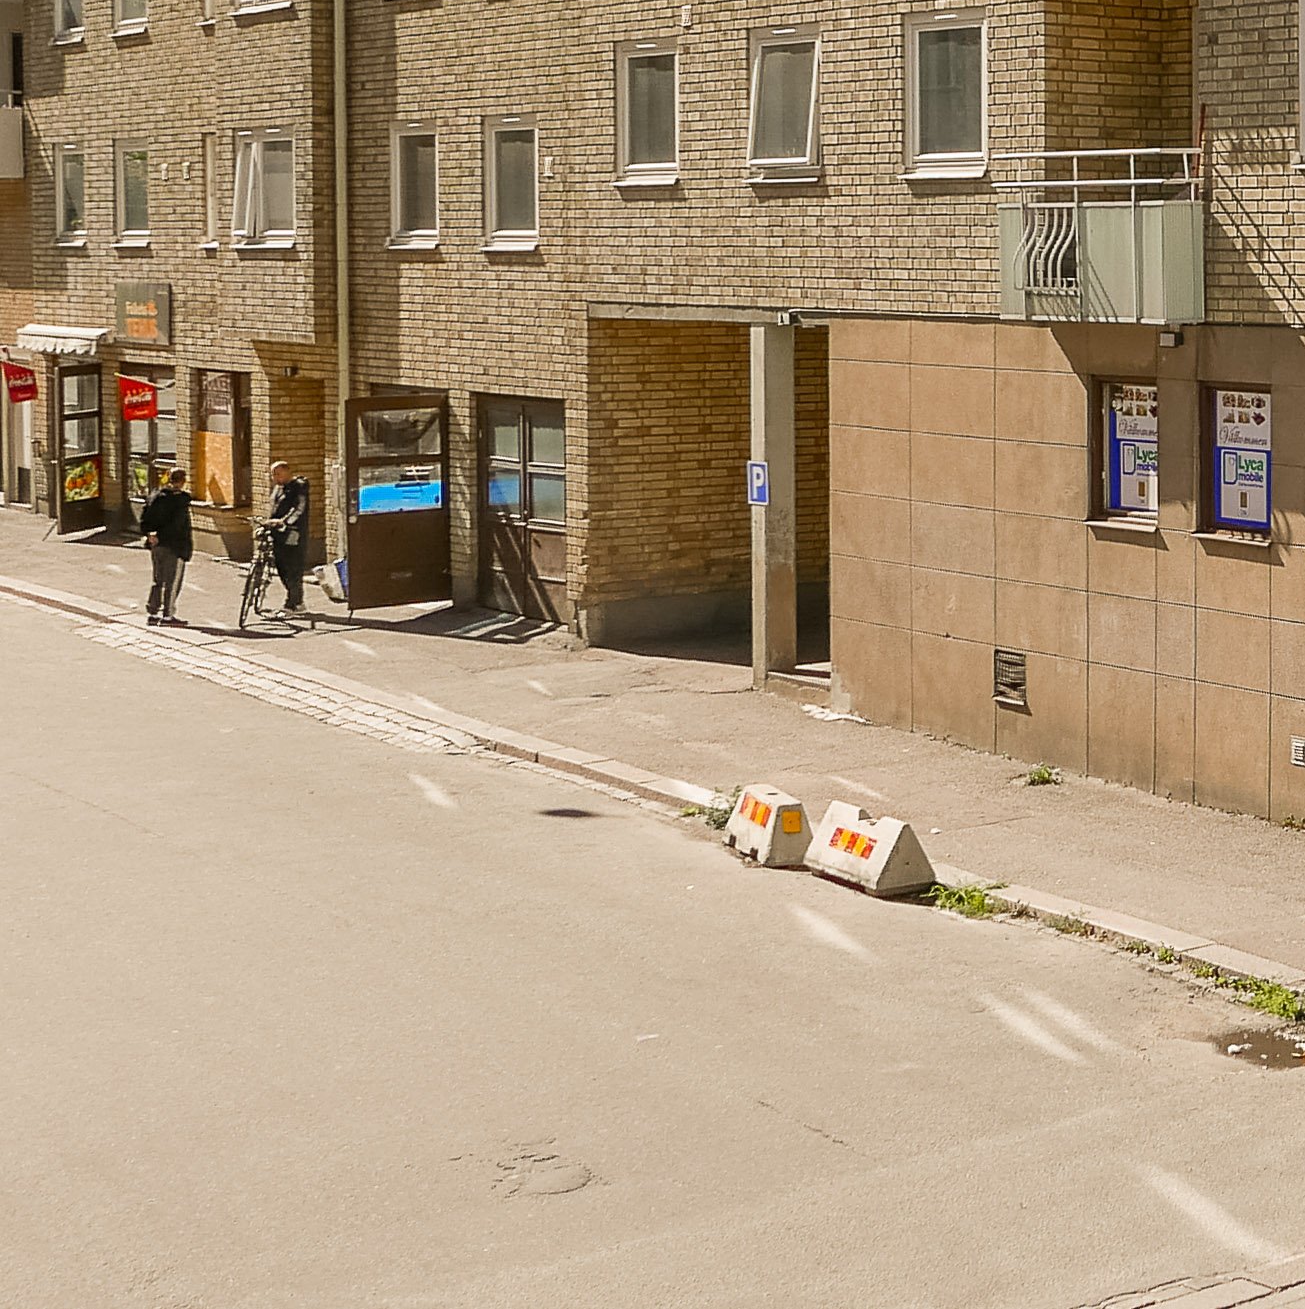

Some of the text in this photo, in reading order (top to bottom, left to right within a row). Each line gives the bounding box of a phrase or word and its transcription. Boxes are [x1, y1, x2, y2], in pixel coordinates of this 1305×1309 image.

[1239, 455, 1264, 472] Lyca
[752, 466, 765, 499] P
[1239, 472, 1264, 483] mobile
